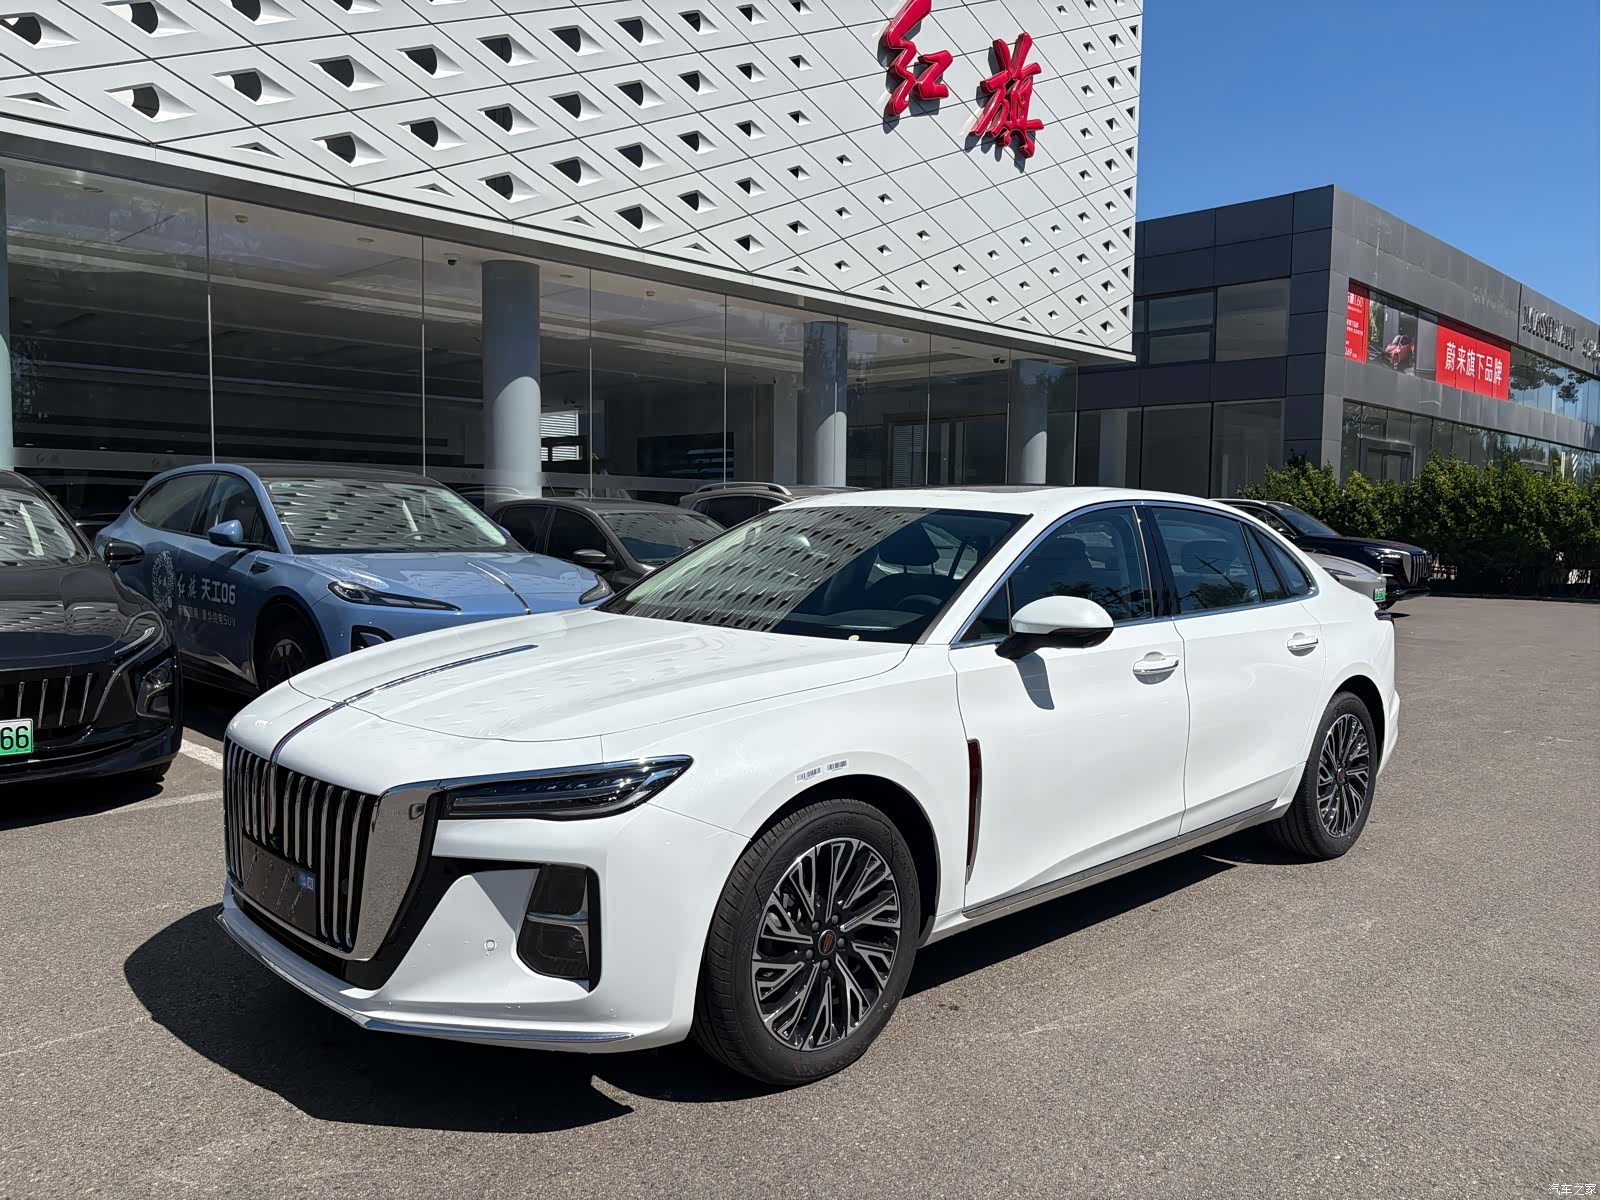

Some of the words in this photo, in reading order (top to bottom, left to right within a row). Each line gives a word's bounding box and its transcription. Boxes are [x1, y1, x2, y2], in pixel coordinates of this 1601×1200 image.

[882, 0, 1044, 158] 红旗
[1444, 342, 1502, 385] 蔚来旗下品牌
[202, 578, 236, 605] 天工06
[0, 726, 29, 750] 66
